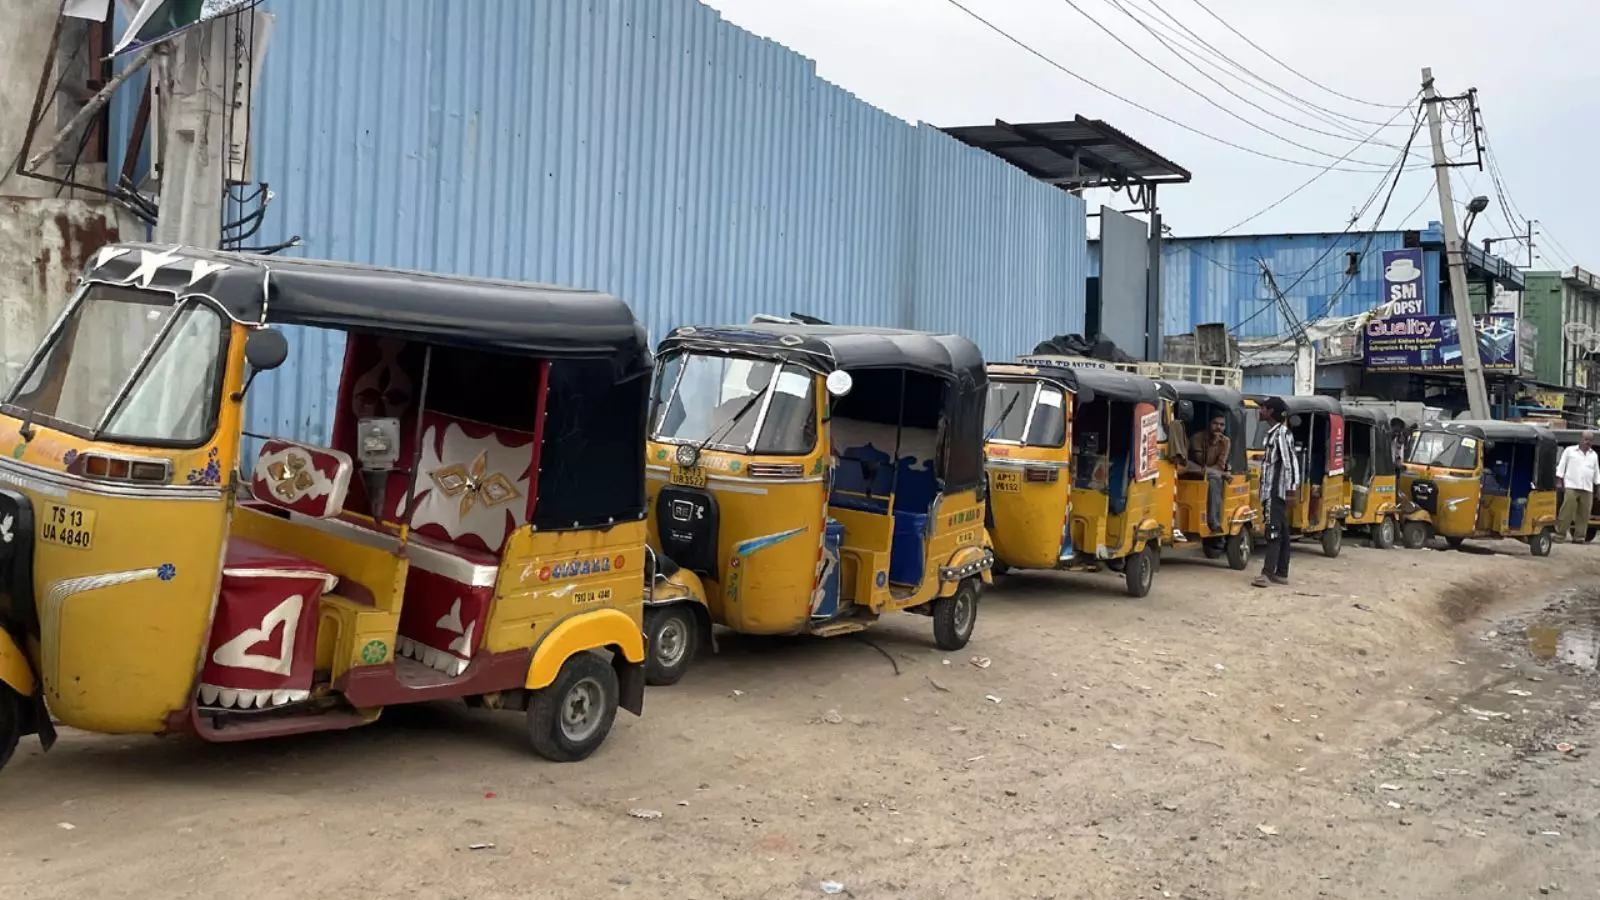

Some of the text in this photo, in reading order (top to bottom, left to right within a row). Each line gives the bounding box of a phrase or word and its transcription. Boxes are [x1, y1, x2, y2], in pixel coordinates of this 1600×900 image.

[1391, 284, 1417, 300] SM
[1393, 300, 1422, 315] OPSY
[1368, 319, 1436, 337] Quality
[52, 506, 83, 527] TS 13
[43, 523, 90, 547] UA 4840
